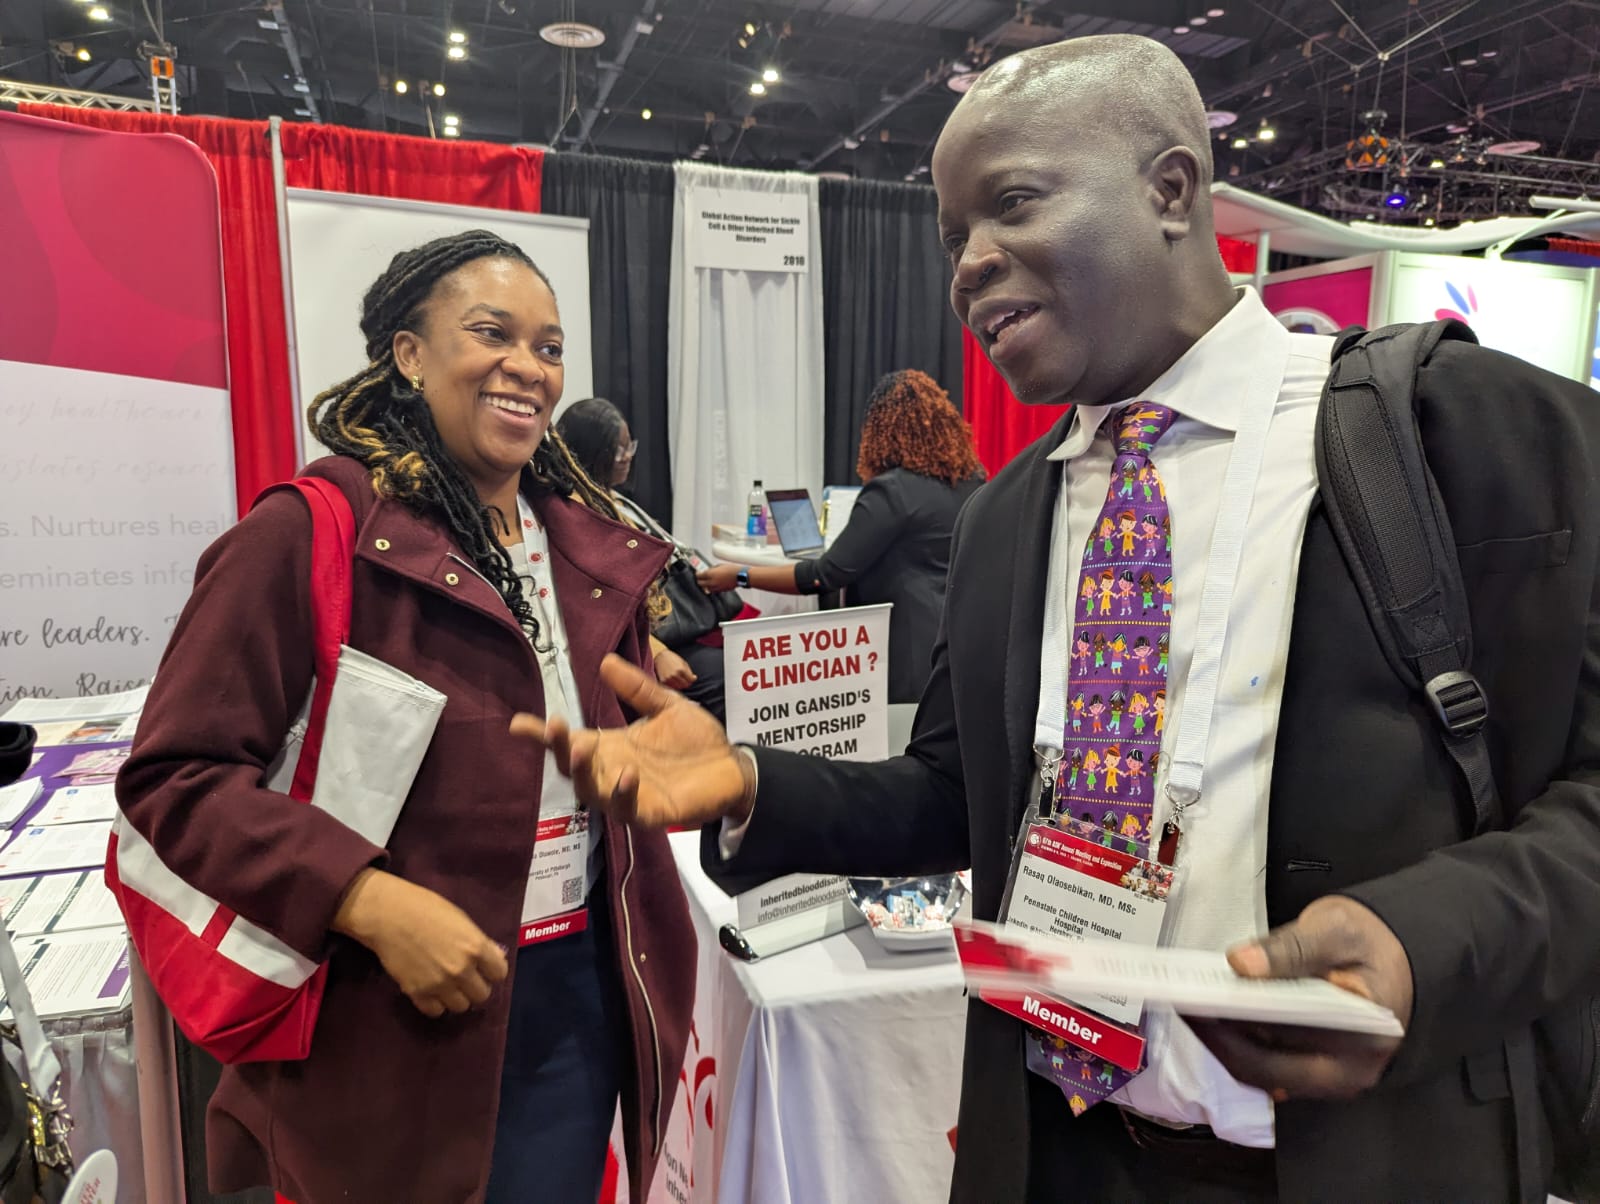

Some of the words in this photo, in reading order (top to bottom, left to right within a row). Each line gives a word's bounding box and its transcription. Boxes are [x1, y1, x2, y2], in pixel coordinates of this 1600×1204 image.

[702, 211, 722, 220] Global
[723, 213, 743, 221] Action
[745, 215, 769, 223] Network
[771, 216, 780, 224] for
[728, 224, 744, 232] Other
[746, 225, 774, 233] Inherited
[736, 235, 766, 243] Disorders
[32, 515, 160, 537] Nurtures
[0, 565, 133, 589] eminates
[42, 616, 150, 648] leaders.
[742, 635, 792, 662] ARE
[799, 628, 847, 652] YOU
[856, 625, 870, 645] A
[741, 655, 861, 692] CLINICIAN
[749, 703, 790, 724] JOIN
[796, 689, 871, 715] GANSID'S
[757, 713, 866, 747] MENTORSHIP
[1024, 865, 1045, 882] Rasaq
[1047, 875, 1095, 901] Olaosebikan,
[1099, 894, 1115, 909] MD,
[1118, 901, 1137, 916] MSc
[525, 921, 571, 940] Member
[1024, 895, 1057, 915] Pennstate
[1059, 909, 1089, 927] Children
[1091, 922, 1122, 940] Hospital
[1054, 917, 1084, 935] Hospital
[1022, 995, 1102, 1045] Member
